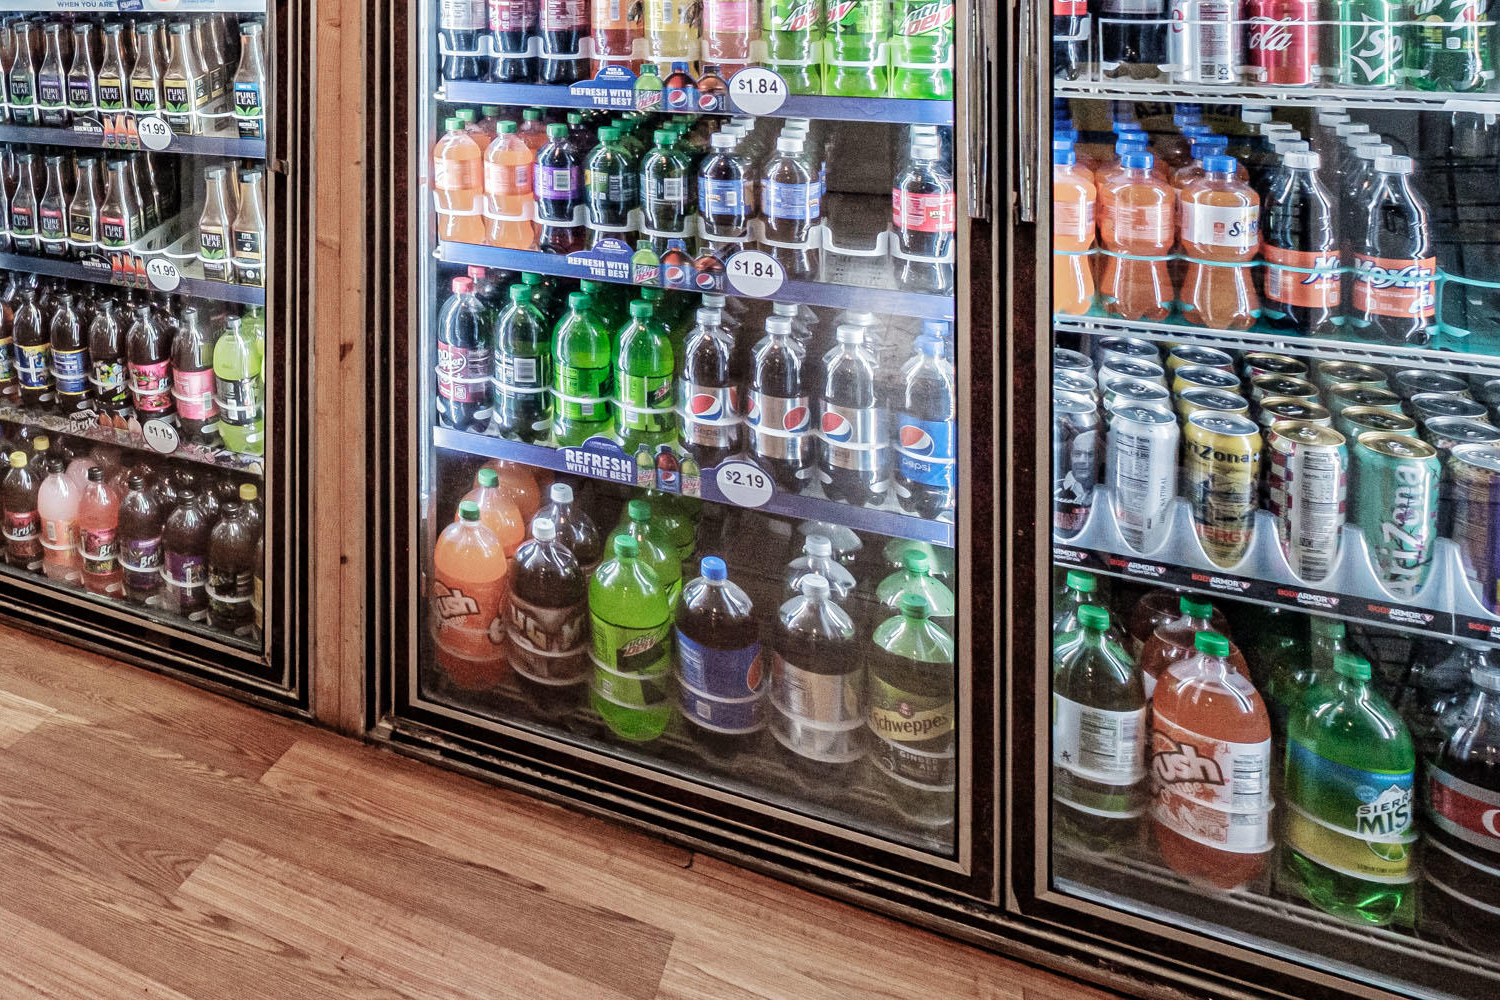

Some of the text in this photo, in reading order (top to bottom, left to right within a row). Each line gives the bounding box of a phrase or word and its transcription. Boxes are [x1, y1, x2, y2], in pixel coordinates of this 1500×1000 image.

[166, 88, 185, 96] PURE
[570, 87, 632, 98] REFRESH WITH
[739, 78, 779, 95] $1.84
[592, 96, 632, 106] THE BEST
[142, 122, 166, 136] $1.99
[104, 231, 124, 239] LEAF
[201, 233, 220, 241] PURE
[151, 264, 176, 277] $1.99
[567, 256, 630, 271] REFRESH WITH
[734, 260, 774, 278] $1.84
[590, 267, 607, 276] THE
[608, 269, 630, 279] BEST
[70, 418, 99, 432] Brisk
[565, 449, 632, 474] REFRESH
[901, 457, 931, 473] pepsi
[565, 462, 633, 482] WITH THE BEST
[725, 470, 765, 489] $2.19
[874, 714, 949, 737] Schweppes
[899, 750, 938, 765] GINGER
[1359, 788, 1413, 817] SIERR
[1358, 803, 1410, 838] MIS
